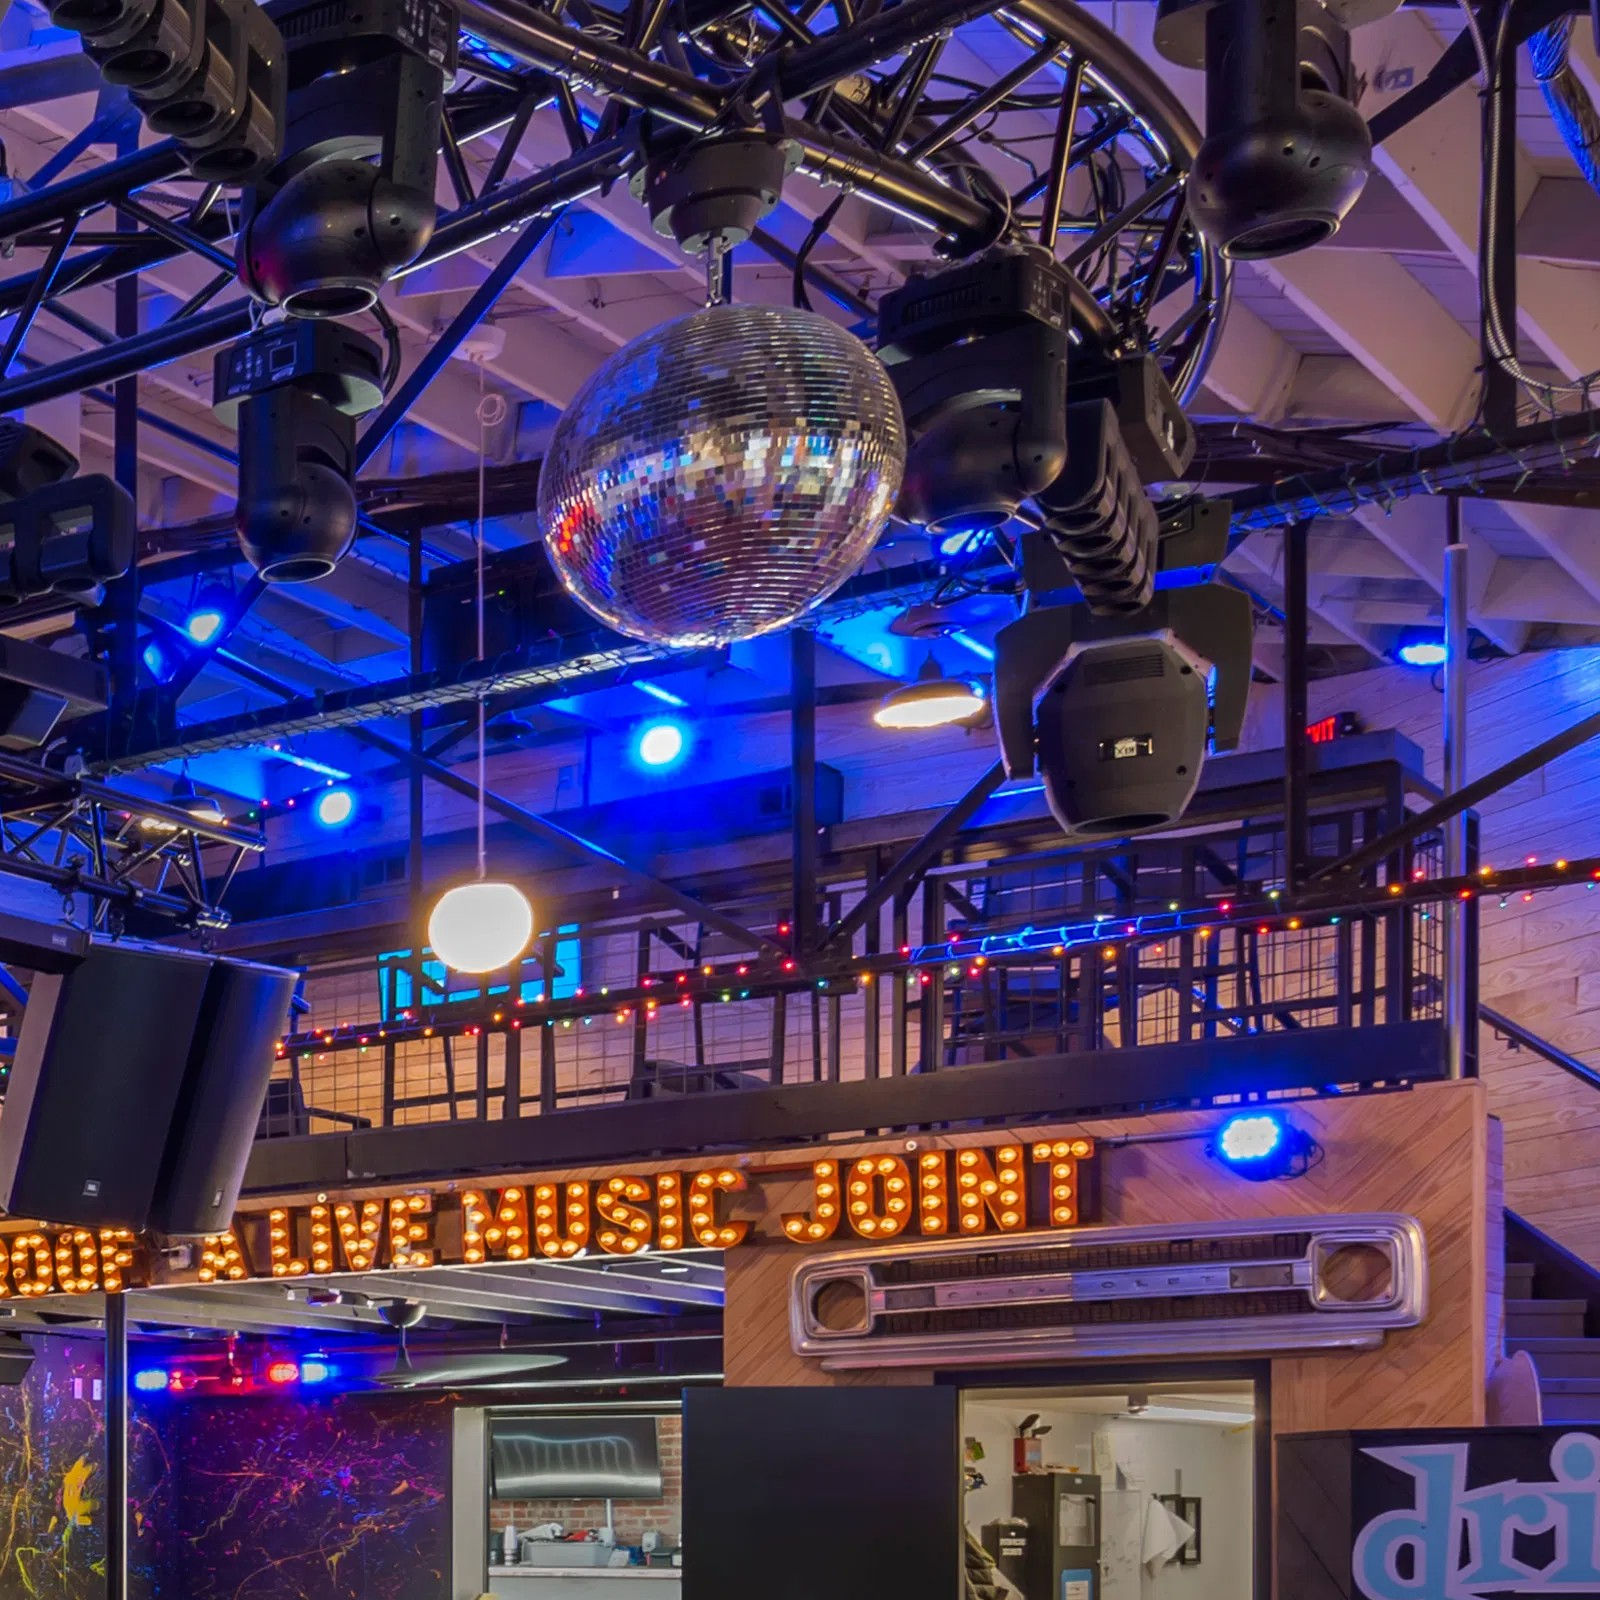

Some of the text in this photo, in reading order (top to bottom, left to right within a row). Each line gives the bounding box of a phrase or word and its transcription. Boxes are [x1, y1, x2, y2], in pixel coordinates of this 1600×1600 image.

[1304, 717, 1335, 743] XIT
[198, 1231, 250, 1284] A
[268, 1195, 434, 1278] LIVE
[461, 1167, 755, 1264] MUSIC
[780, 1137, 1095, 1244] JOINT
